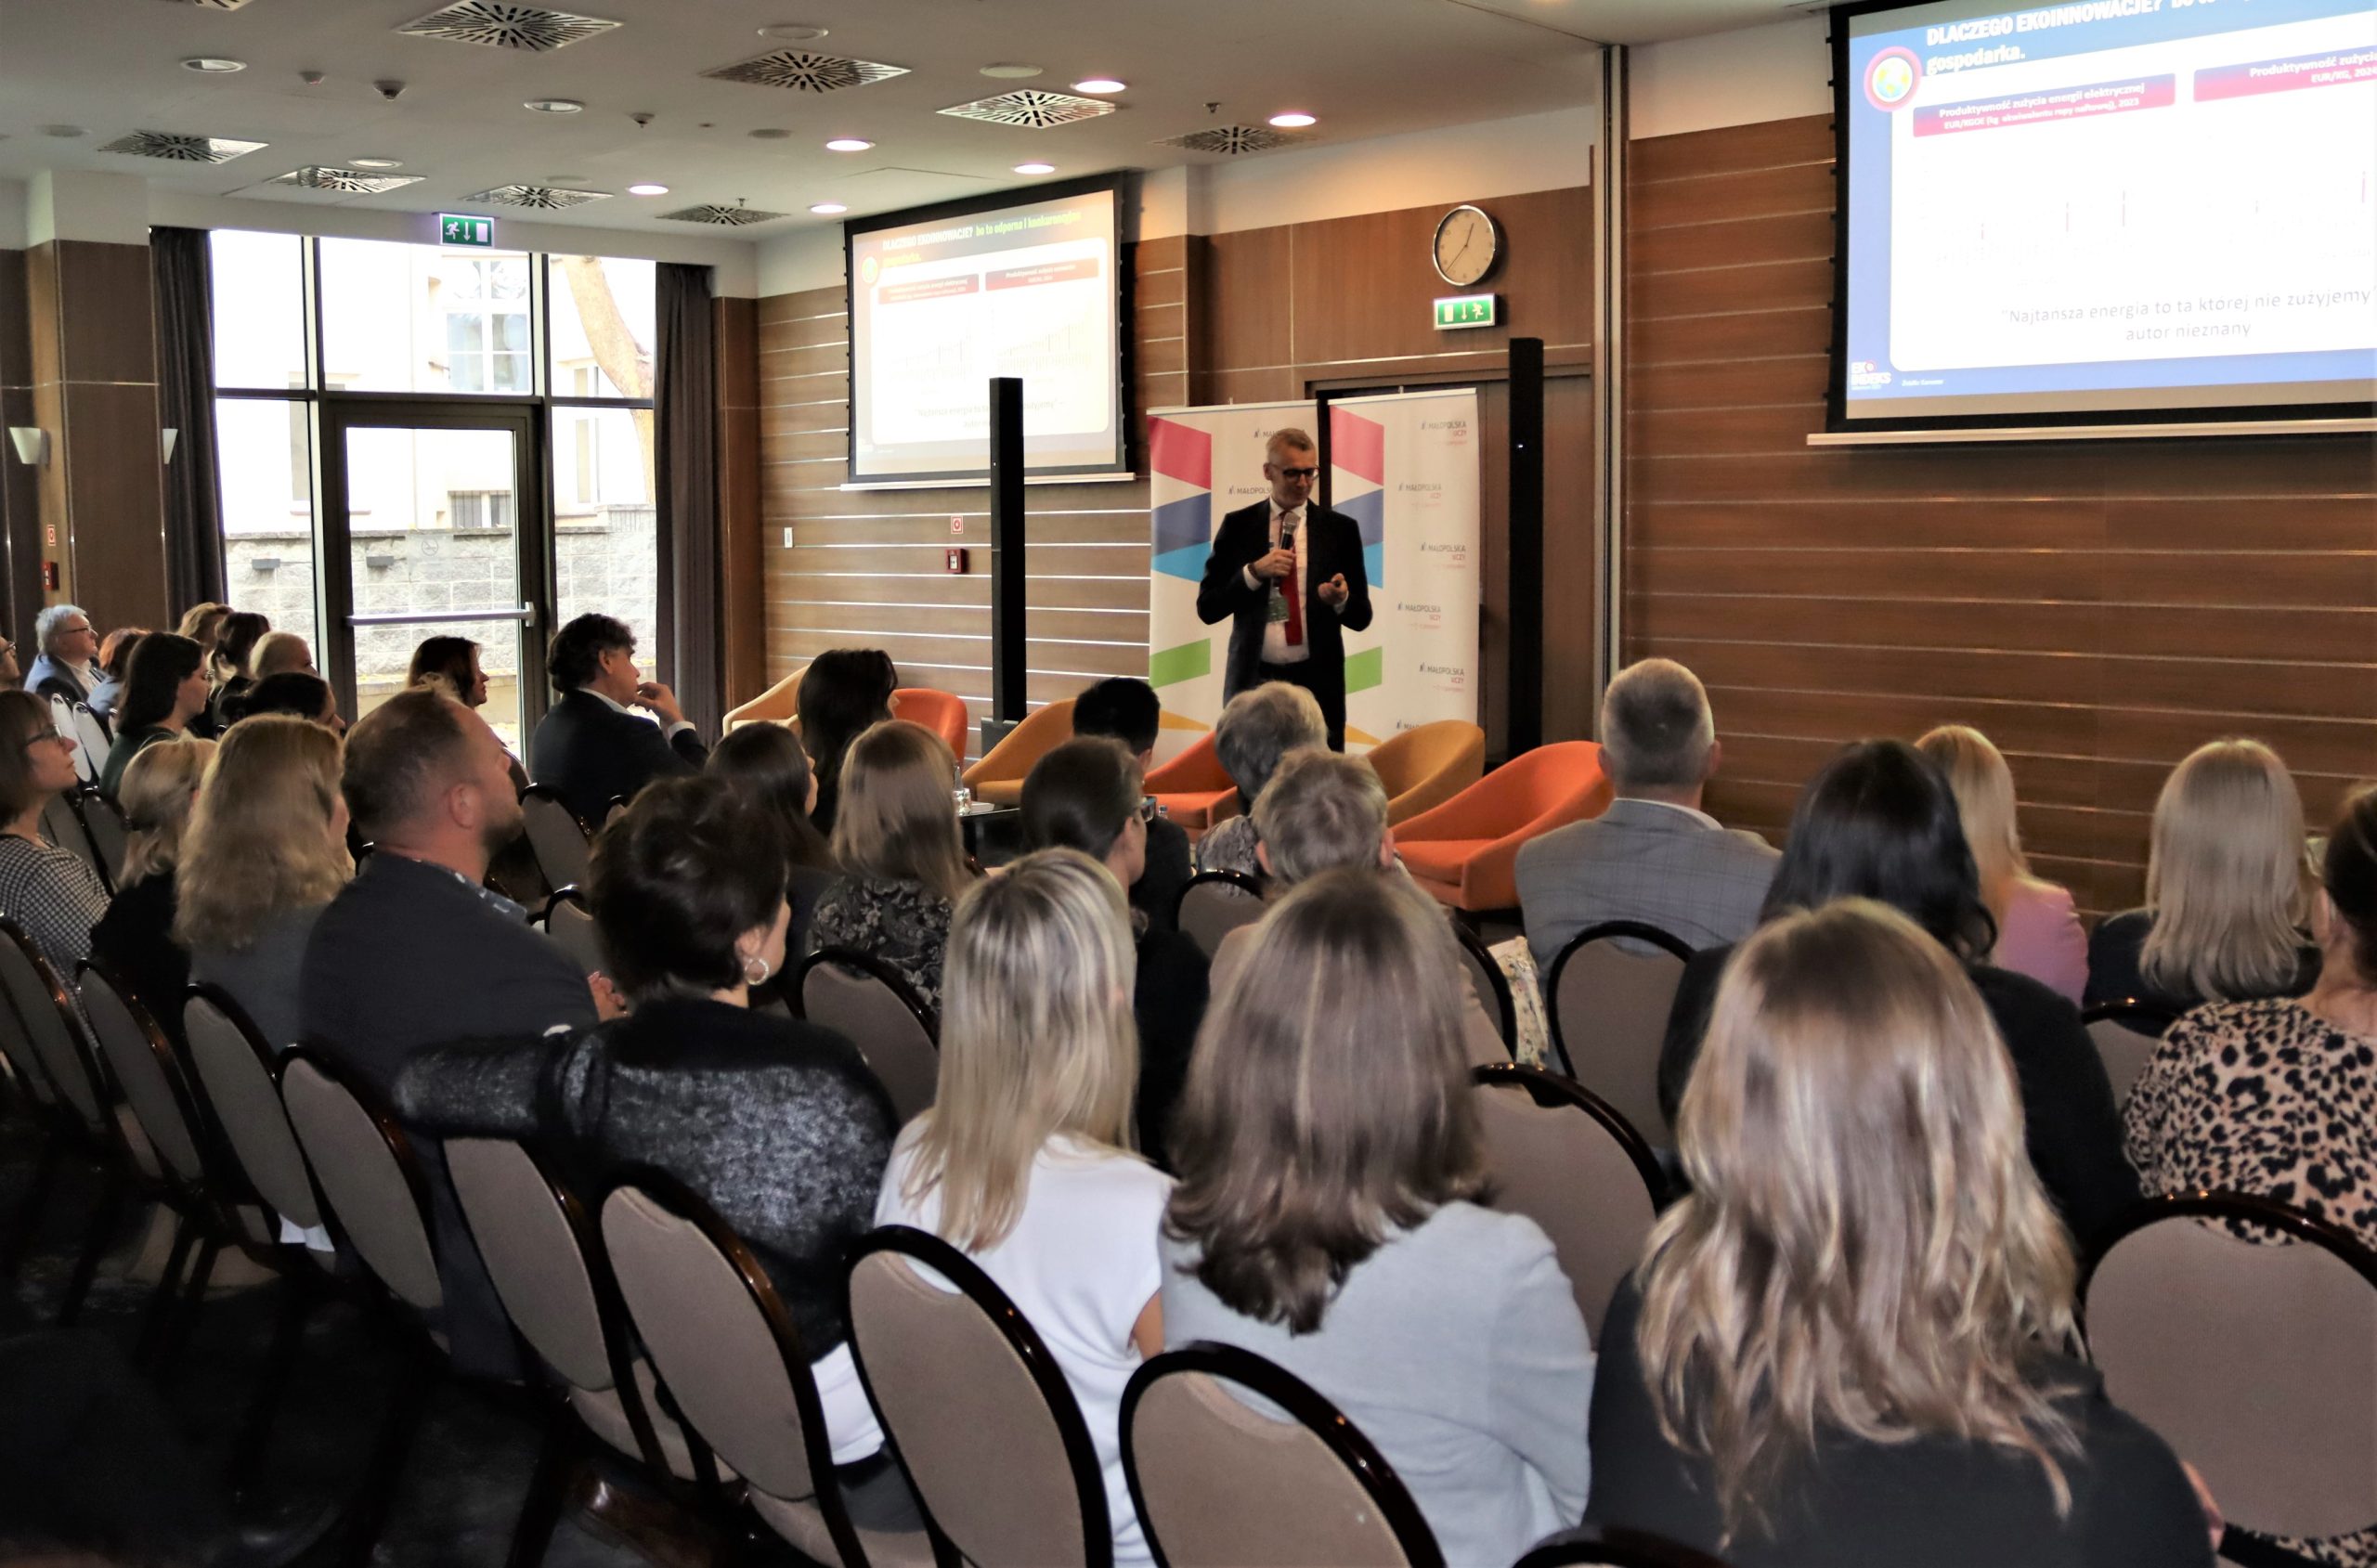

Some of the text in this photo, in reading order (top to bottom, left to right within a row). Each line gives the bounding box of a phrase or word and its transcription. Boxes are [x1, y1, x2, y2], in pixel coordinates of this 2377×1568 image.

[1927, 16, 2013, 46] DLACZEGO
[2016, 0, 2163, 33] EKOINNOWACJE?
[1927, 44, 2026, 76] gospodarka.
[2249, 57, 2337, 79] Produktywność
[1939, 82, 2145, 119] Produktywność zużycia energii elektrycznej
[2089, 301, 2150, 320] energia
[2154, 298, 2173, 315] to
[2176, 296, 2193, 313] ta
[2198, 293, 2250, 313] której
[2254, 292, 2281, 308] nie
[2125, 321, 2252, 343] autor nieznany
[1237, 486, 1272, 495] MAŁOPOLS
[1427, 665, 1464, 677] MAŁOPOLSKA
